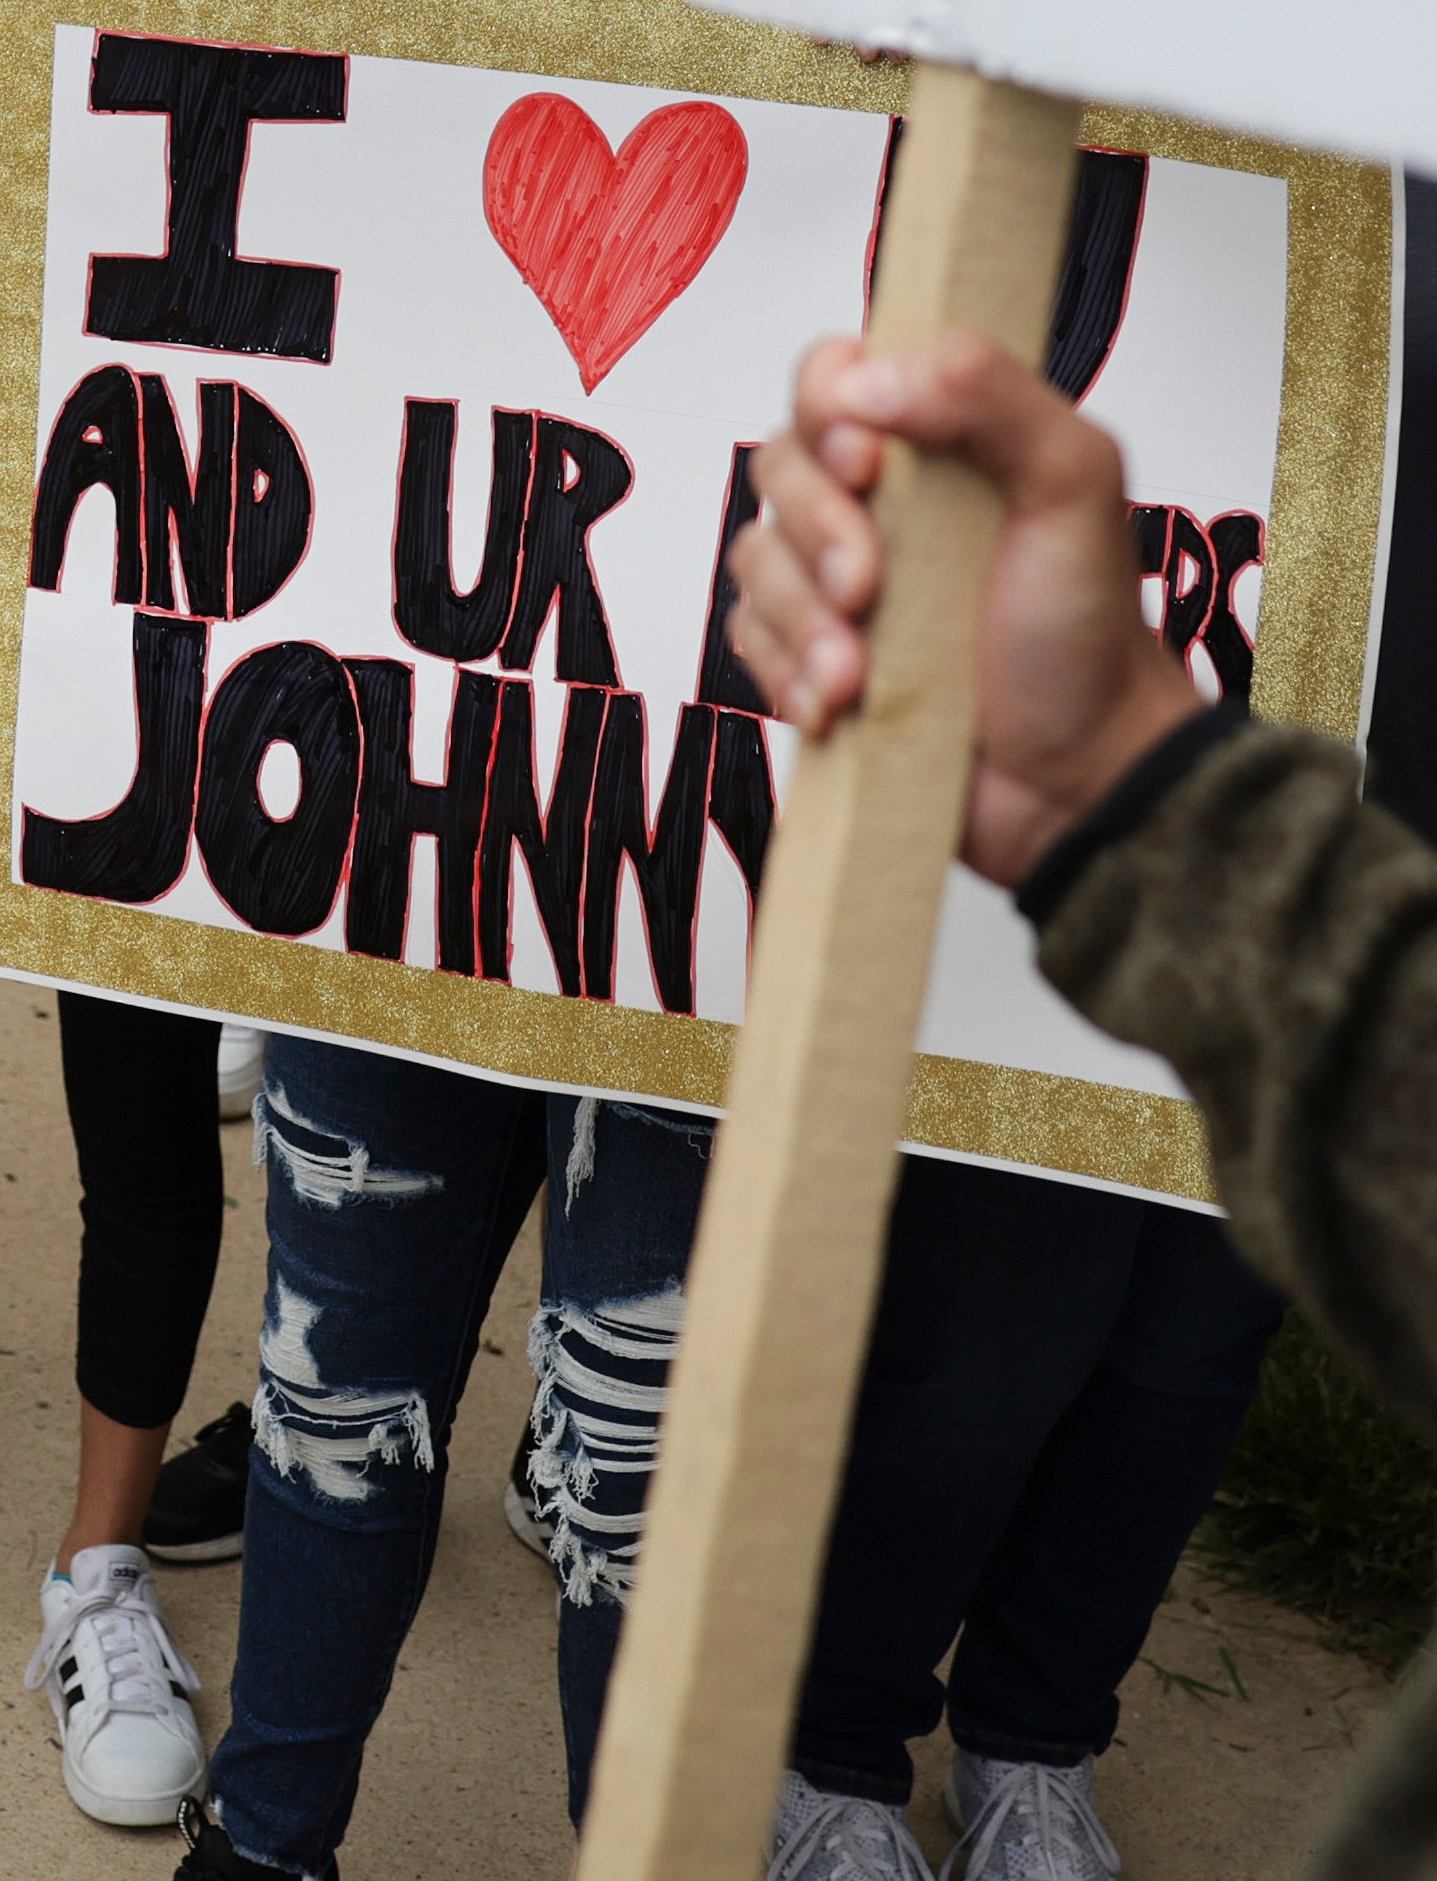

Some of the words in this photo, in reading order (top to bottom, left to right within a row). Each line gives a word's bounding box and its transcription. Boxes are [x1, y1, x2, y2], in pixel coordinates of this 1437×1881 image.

[81, 28, 351, 366] I
[28, 362, 315, 623] AND
[393, 396, 634, 690] UR
